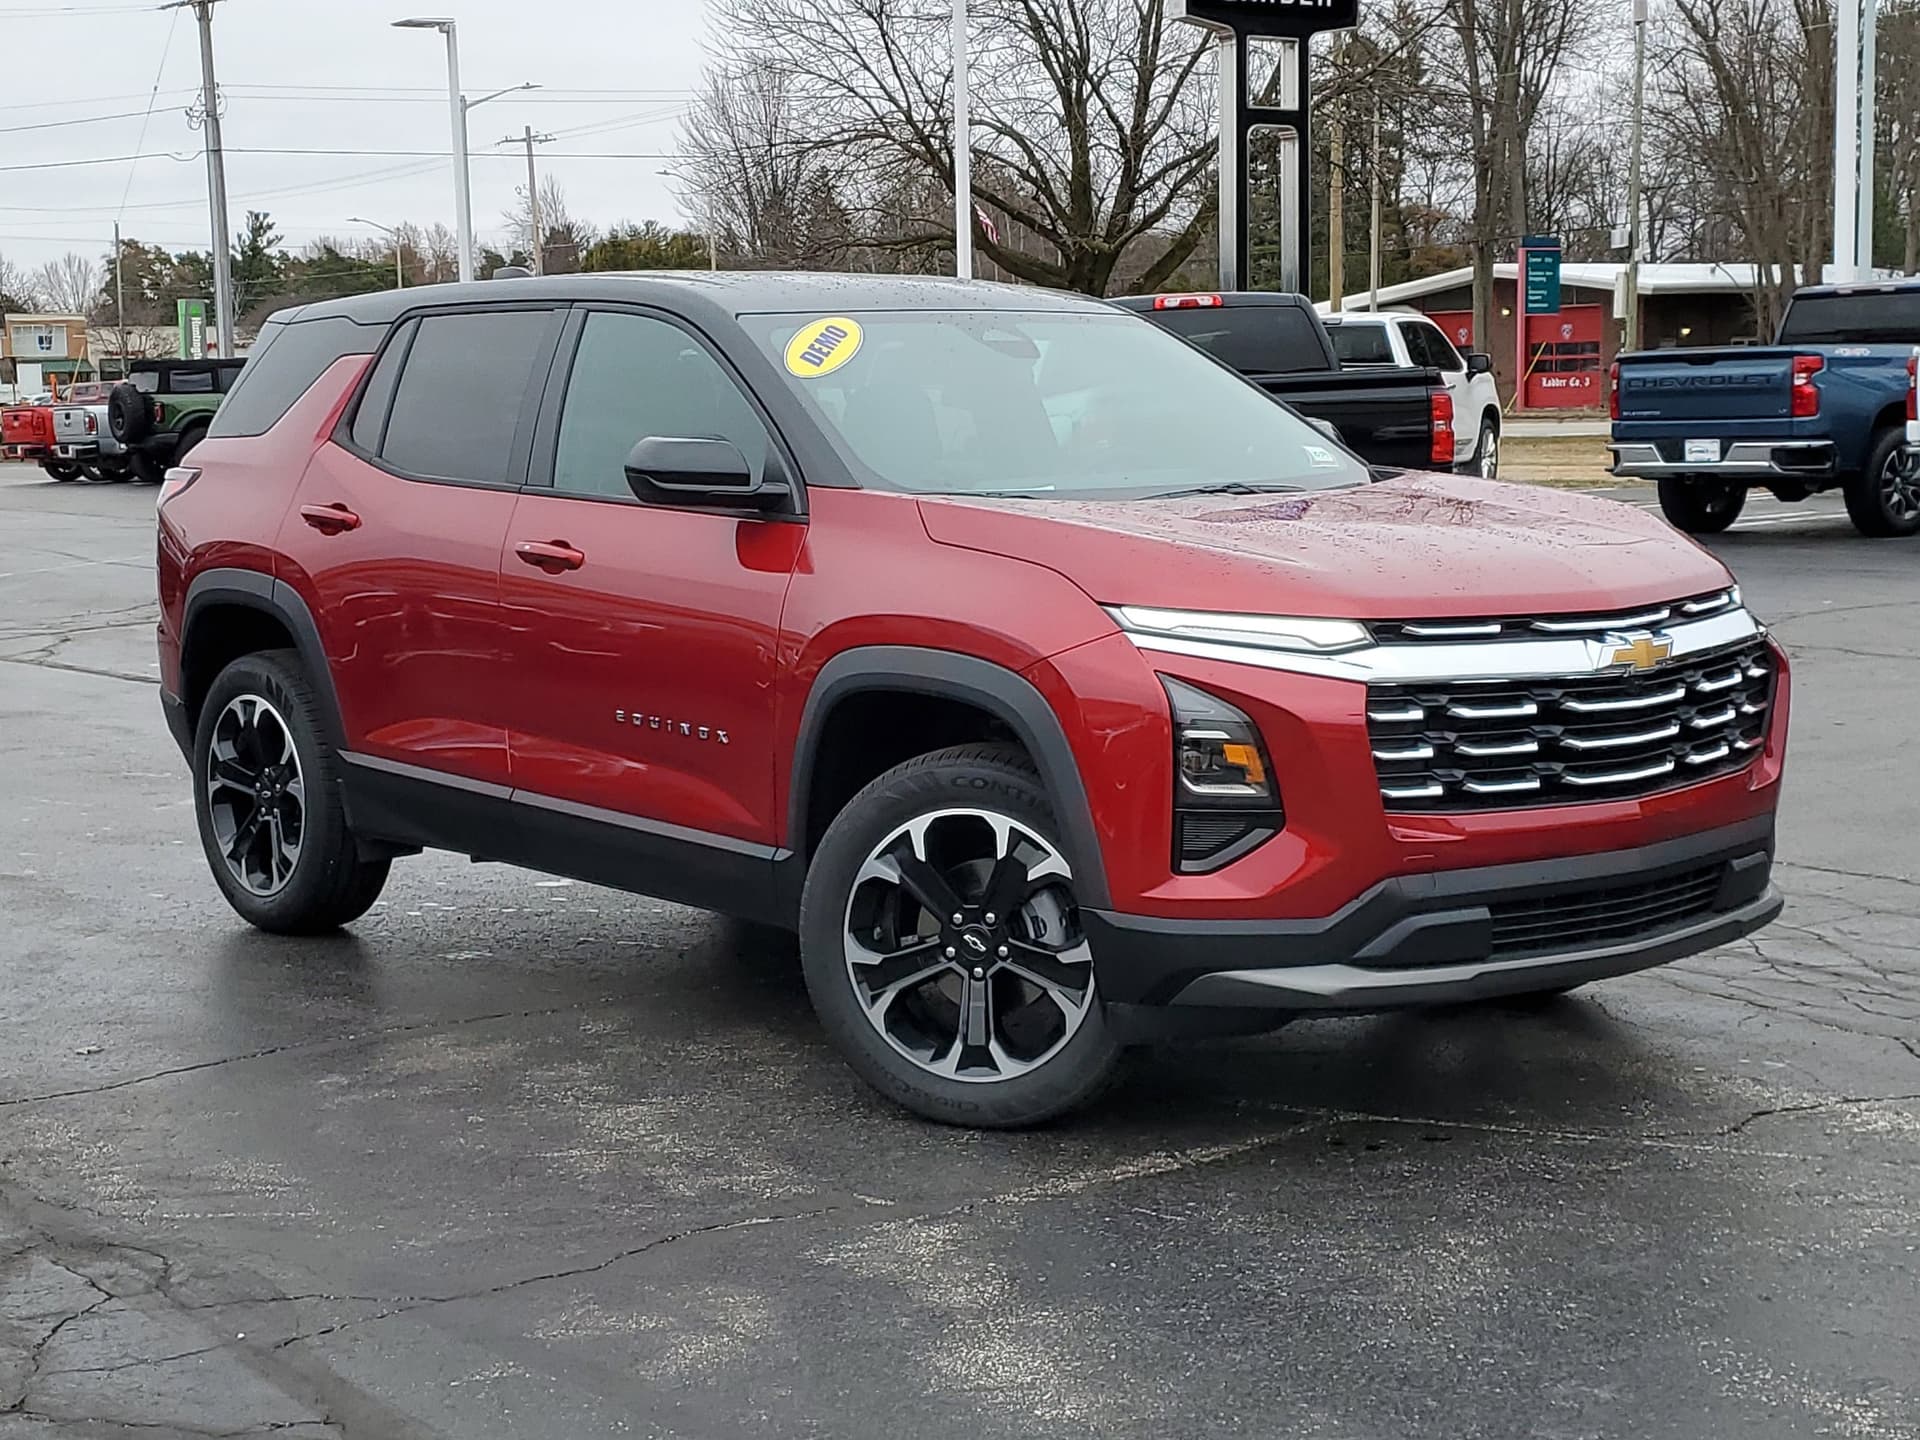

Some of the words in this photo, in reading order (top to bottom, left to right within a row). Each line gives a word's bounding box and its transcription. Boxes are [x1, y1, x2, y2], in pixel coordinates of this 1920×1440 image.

[799, 325, 848, 367] DEMO
[1541, 376, 1568, 388] Ladder
[1569, 376, 1583, 388] Co.
[1625, 373, 1777, 390] CHEVROLET
[615, 709, 729, 744] EQUINOX
